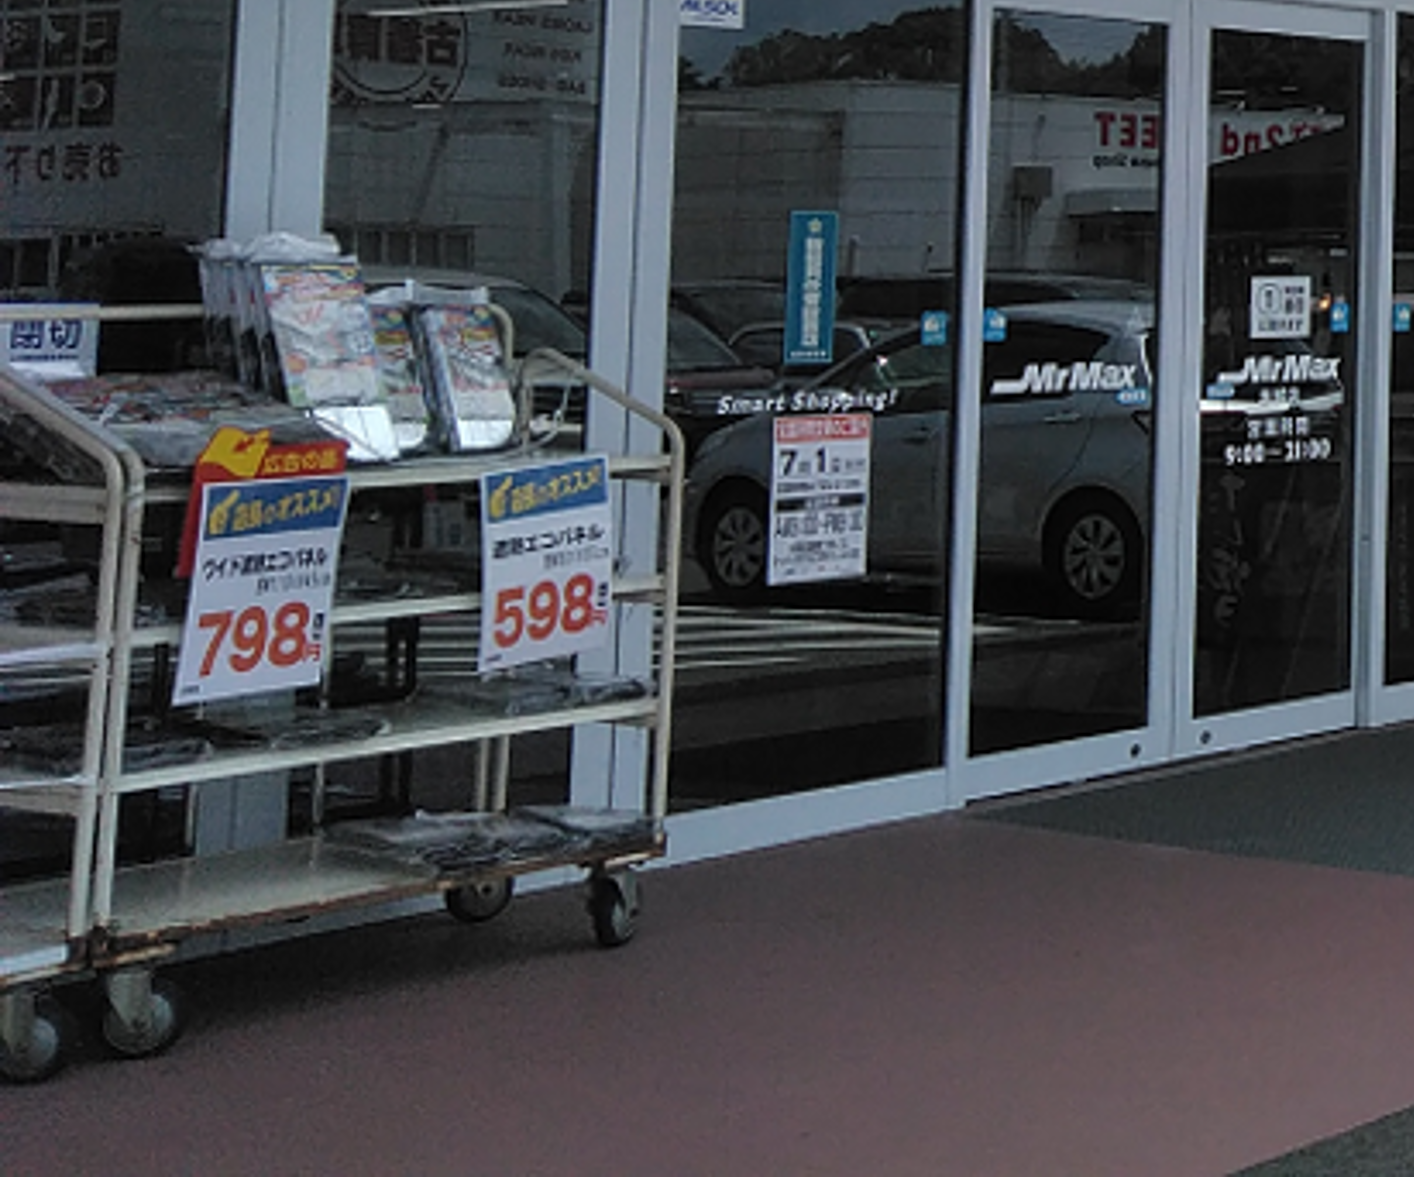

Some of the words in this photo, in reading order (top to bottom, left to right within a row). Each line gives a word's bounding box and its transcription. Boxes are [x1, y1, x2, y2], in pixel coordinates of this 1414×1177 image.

[991, 361, 1136, 394] MrMax
[1219, 355, 1341, 384] MrMax
[717, 394, 786, 415] Smart
[793, 388, 897, 413] Shopping!
[493, 572, 594, 648] 598
[199, 602, 309, 679] 798
